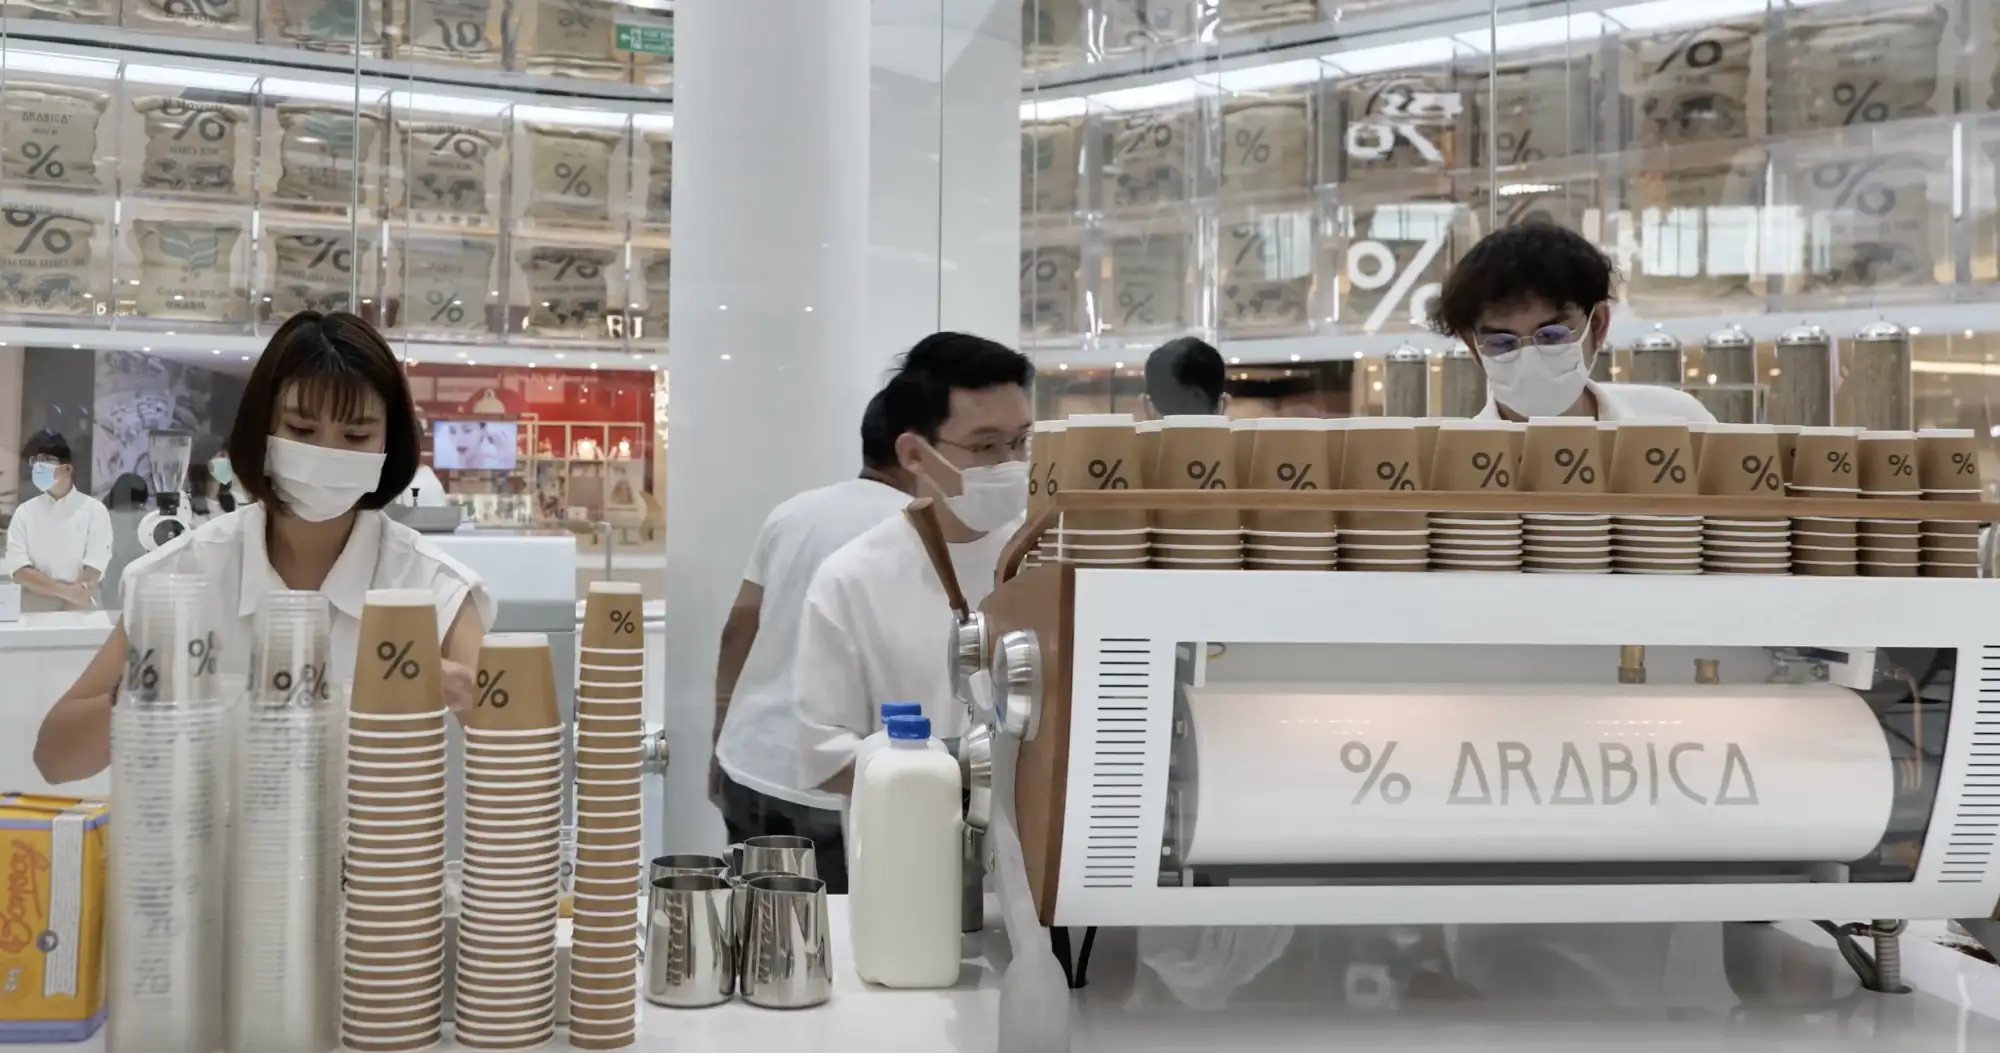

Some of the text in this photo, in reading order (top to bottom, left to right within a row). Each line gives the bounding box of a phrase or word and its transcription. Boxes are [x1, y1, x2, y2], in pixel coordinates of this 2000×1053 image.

[1833, 81, 1889, 126] %
[21, 141, 64, 178] %
[1236, 128, 1270, 164] %
[554, 161, 592, 197] %
[1813, 157, 1896, 215] %
[5, 208, 73, 254] %
[1347, 222, 1450, 333] %
[427, 290, 464, 323] %
[1088, 459, 1129, 489] %
[1187, 460, 1226, 489] %
[1277, 463, 1317, 490] %
[1376, 461, 1413, 490] %
[1472, 452, 1509, 488] %
[1555, 447, 1595, 484] %
[1645, 447, 1686, 483] %
[1742, 455, 1779, 491] %
[1827, 451, 1851, 473] %
[1888, 454, 1912, 476] %
[1952, 453, 1975, 474] %
[610, 609, 635, 634] %
[376, 640, 420, 680] %
[476, 669, 509, 708] %
[1340, 741, 1759, 806] % ARABICA
